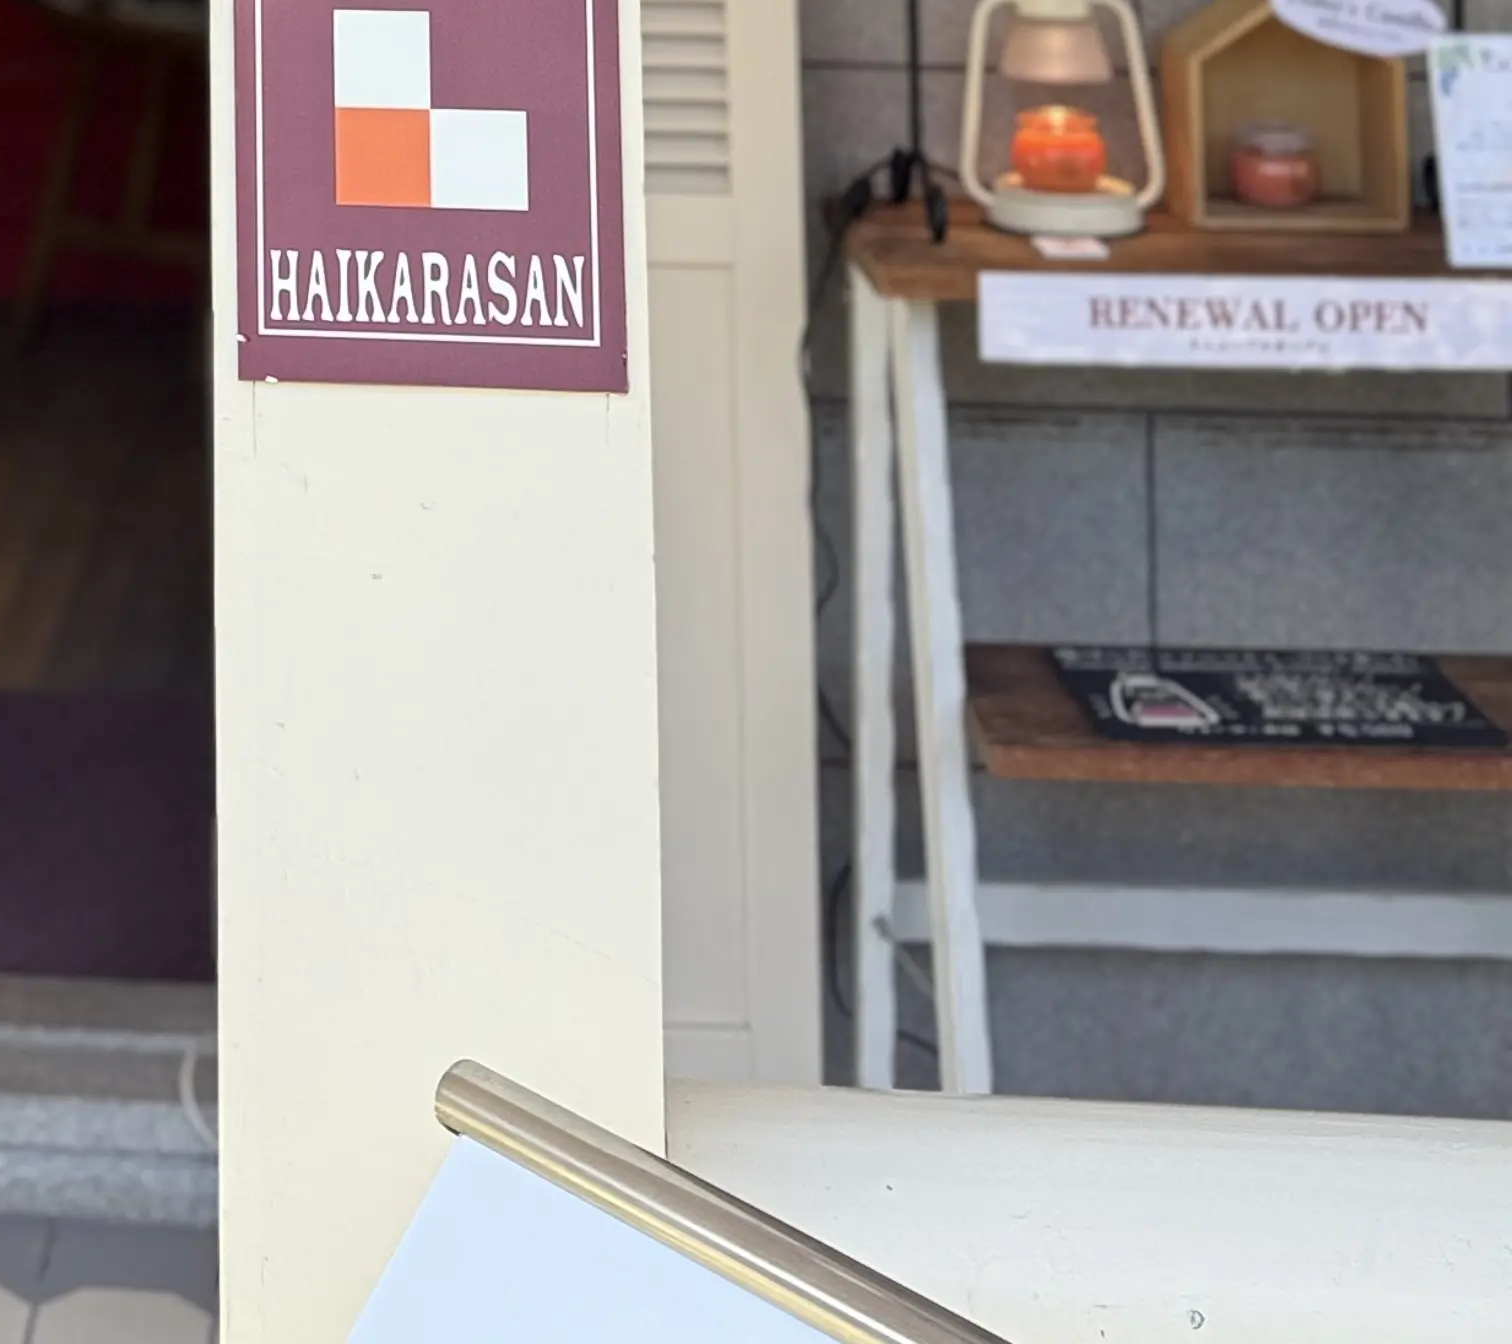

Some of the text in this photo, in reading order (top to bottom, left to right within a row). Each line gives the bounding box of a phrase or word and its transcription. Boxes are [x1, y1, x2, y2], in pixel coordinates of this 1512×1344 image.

[268, 247, 587, 329] HAIKARASAN
[1088, 296, 1430, 334] RENEWAL OPEN
